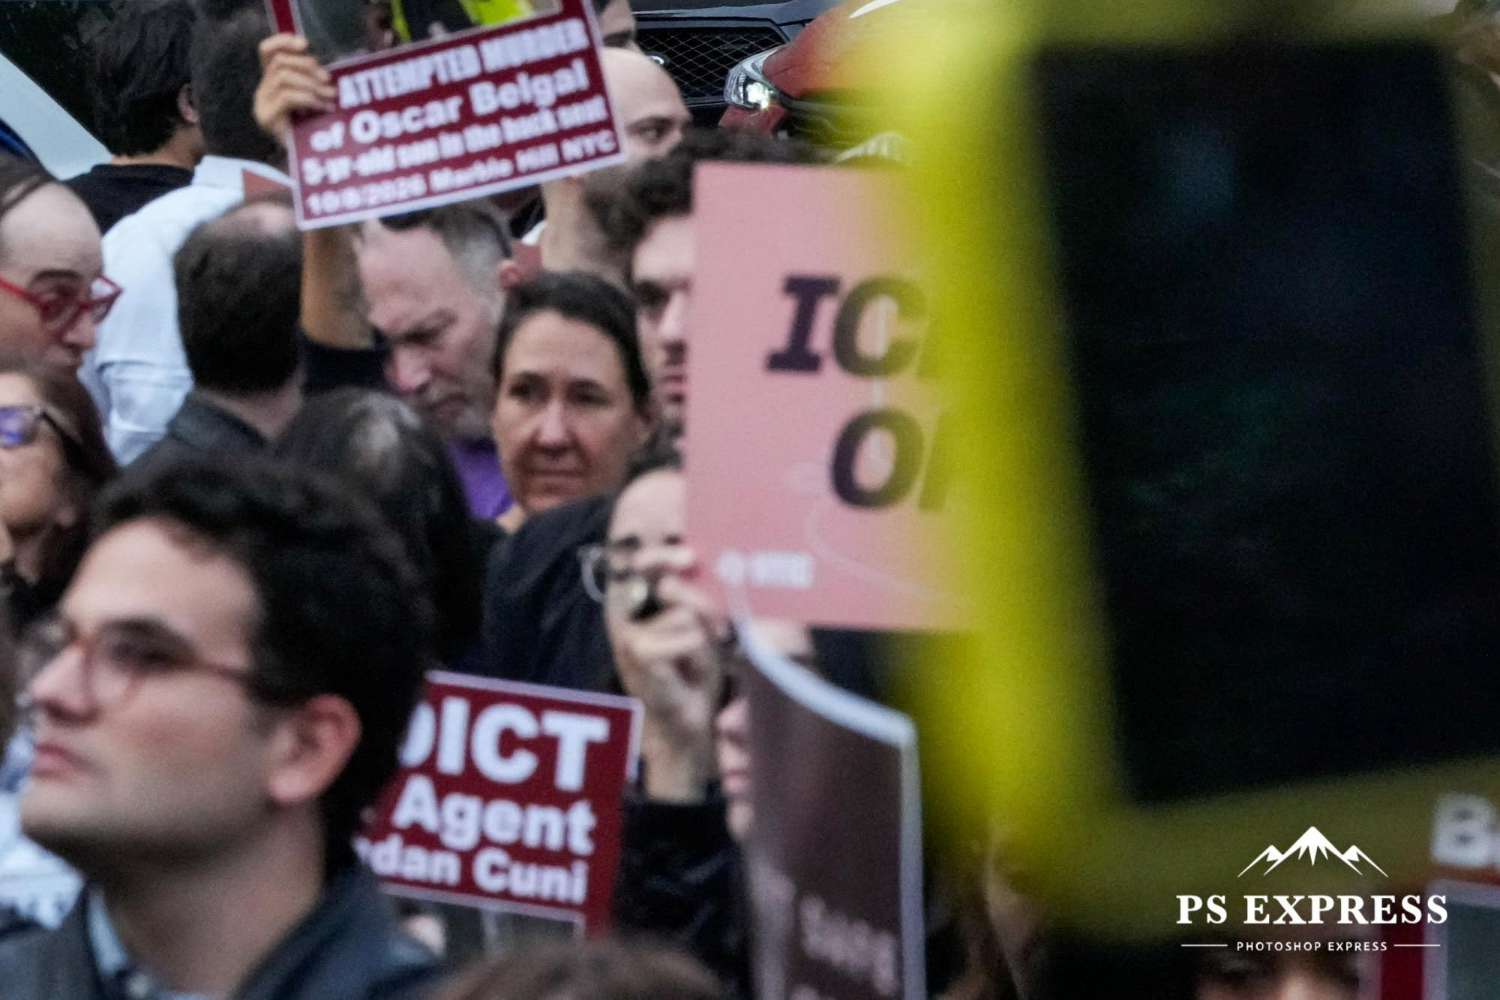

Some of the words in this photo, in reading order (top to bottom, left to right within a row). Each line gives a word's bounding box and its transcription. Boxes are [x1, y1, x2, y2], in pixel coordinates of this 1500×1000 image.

[337, 43, 483, 110] ATTEMPTED
[309, 121, 346, 152] of
[349, 95, 463, 145] Oscar
[560, 128, 617, 163] NYC
[391, 773, 597, 857] Agent
[472, 846, 590, 906] Cuni
